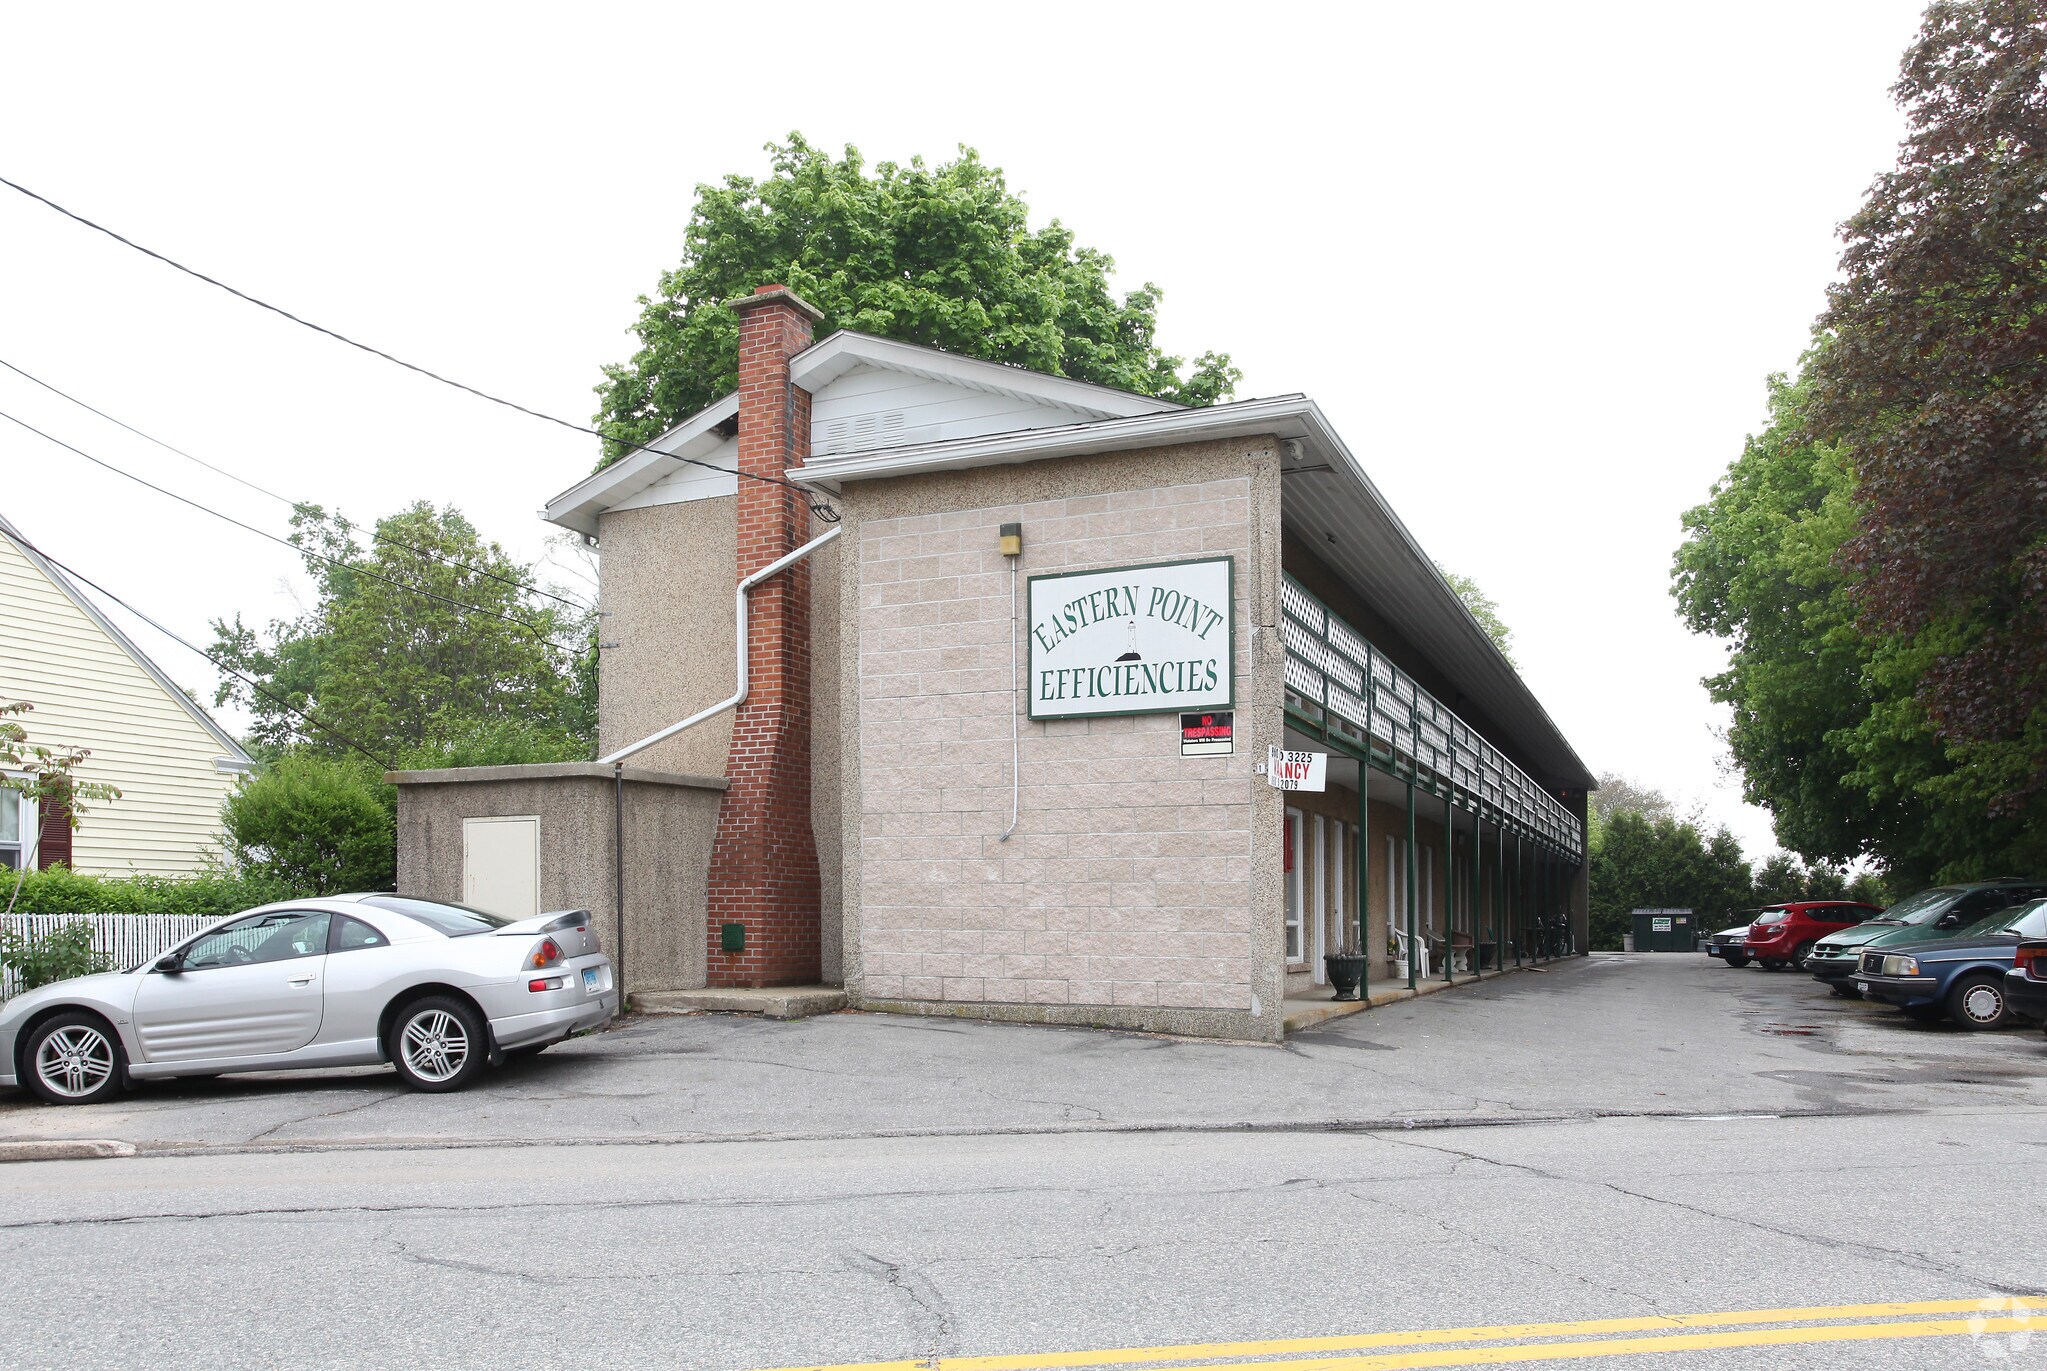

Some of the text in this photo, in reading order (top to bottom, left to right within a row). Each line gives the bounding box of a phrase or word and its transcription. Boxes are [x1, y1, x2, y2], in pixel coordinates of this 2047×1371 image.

[1033, 586, 1224, 654] EASTERN POINT
[1040, 658, 1218, 701] EFFICIENCIES
[1201, 715, 1213, 726] NO
[1183, 726, 1232, 738] TRESPASSING
[1288, 752, 1313, 763] 3225
[1280, 780, 1298, 790] 2079
